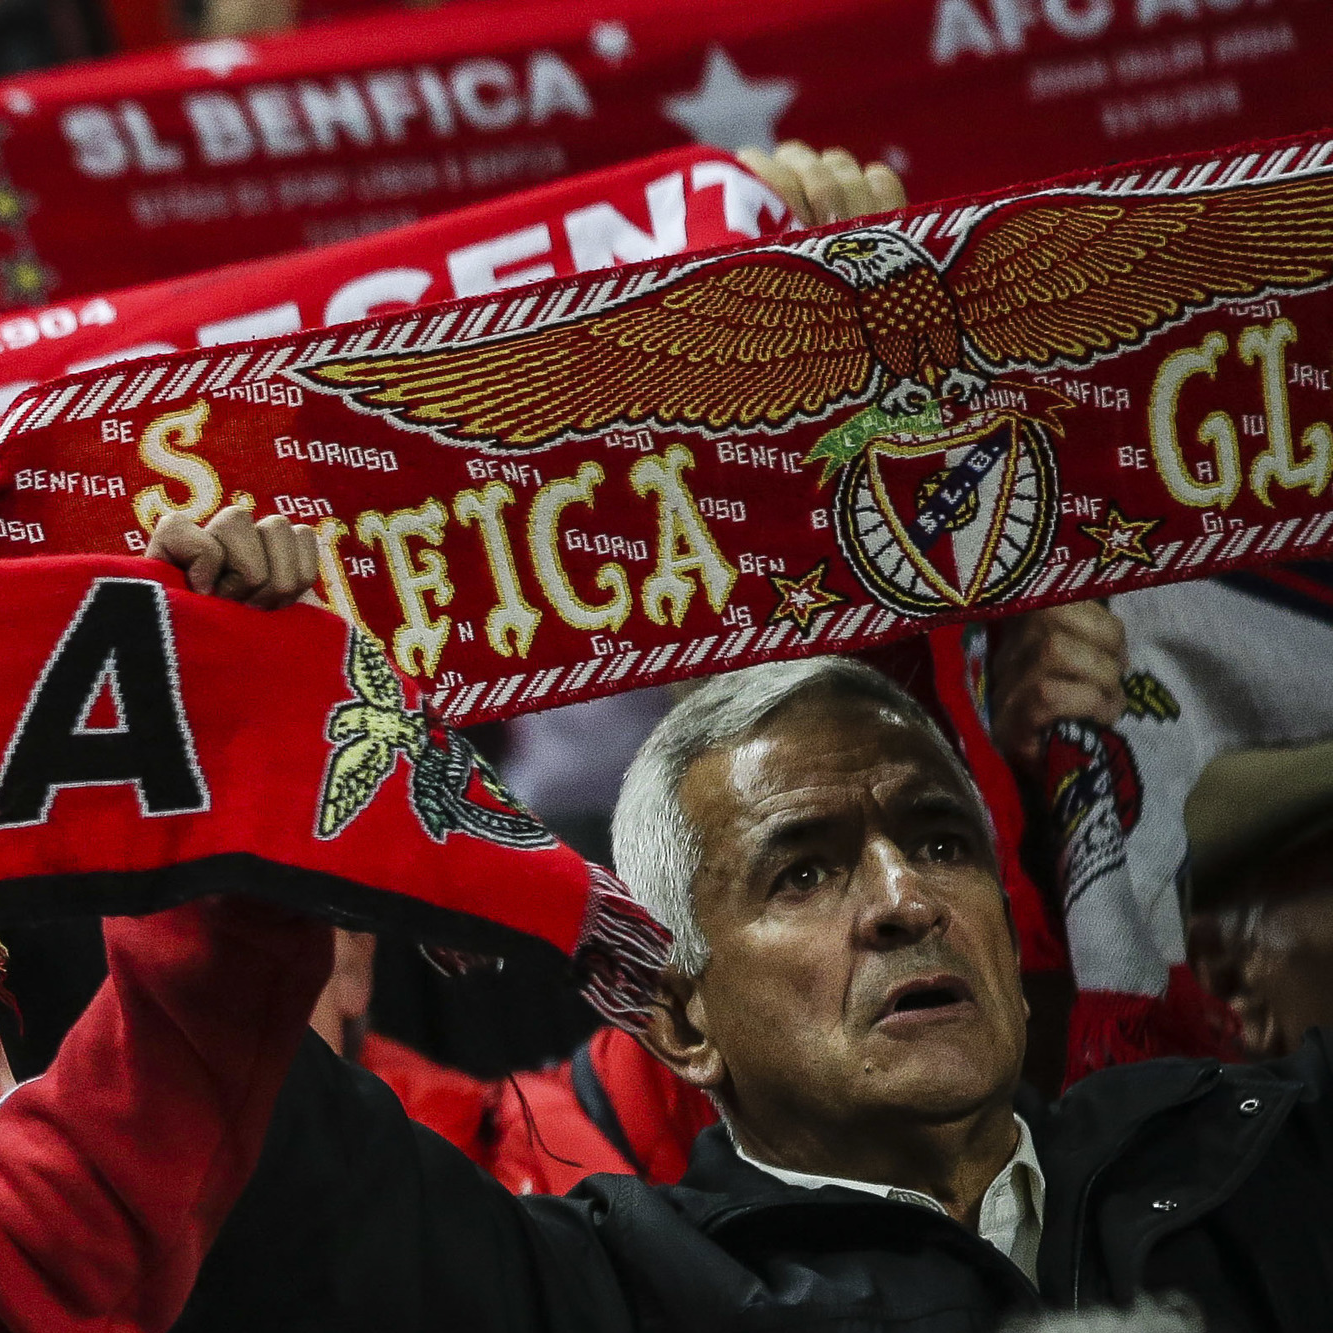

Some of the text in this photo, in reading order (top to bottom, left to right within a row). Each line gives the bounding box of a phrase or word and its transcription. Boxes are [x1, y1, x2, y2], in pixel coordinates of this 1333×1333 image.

[185, 53, 595, 166] BENFICA
[101, 418, 134, 444] BE
[274, 435, 399, 472] GLORIOSO
[1116, 445, 1148, 470] BE
[15, 468, 127, 499] BENFICA
[565, 529, 649, 562] GLORIO
